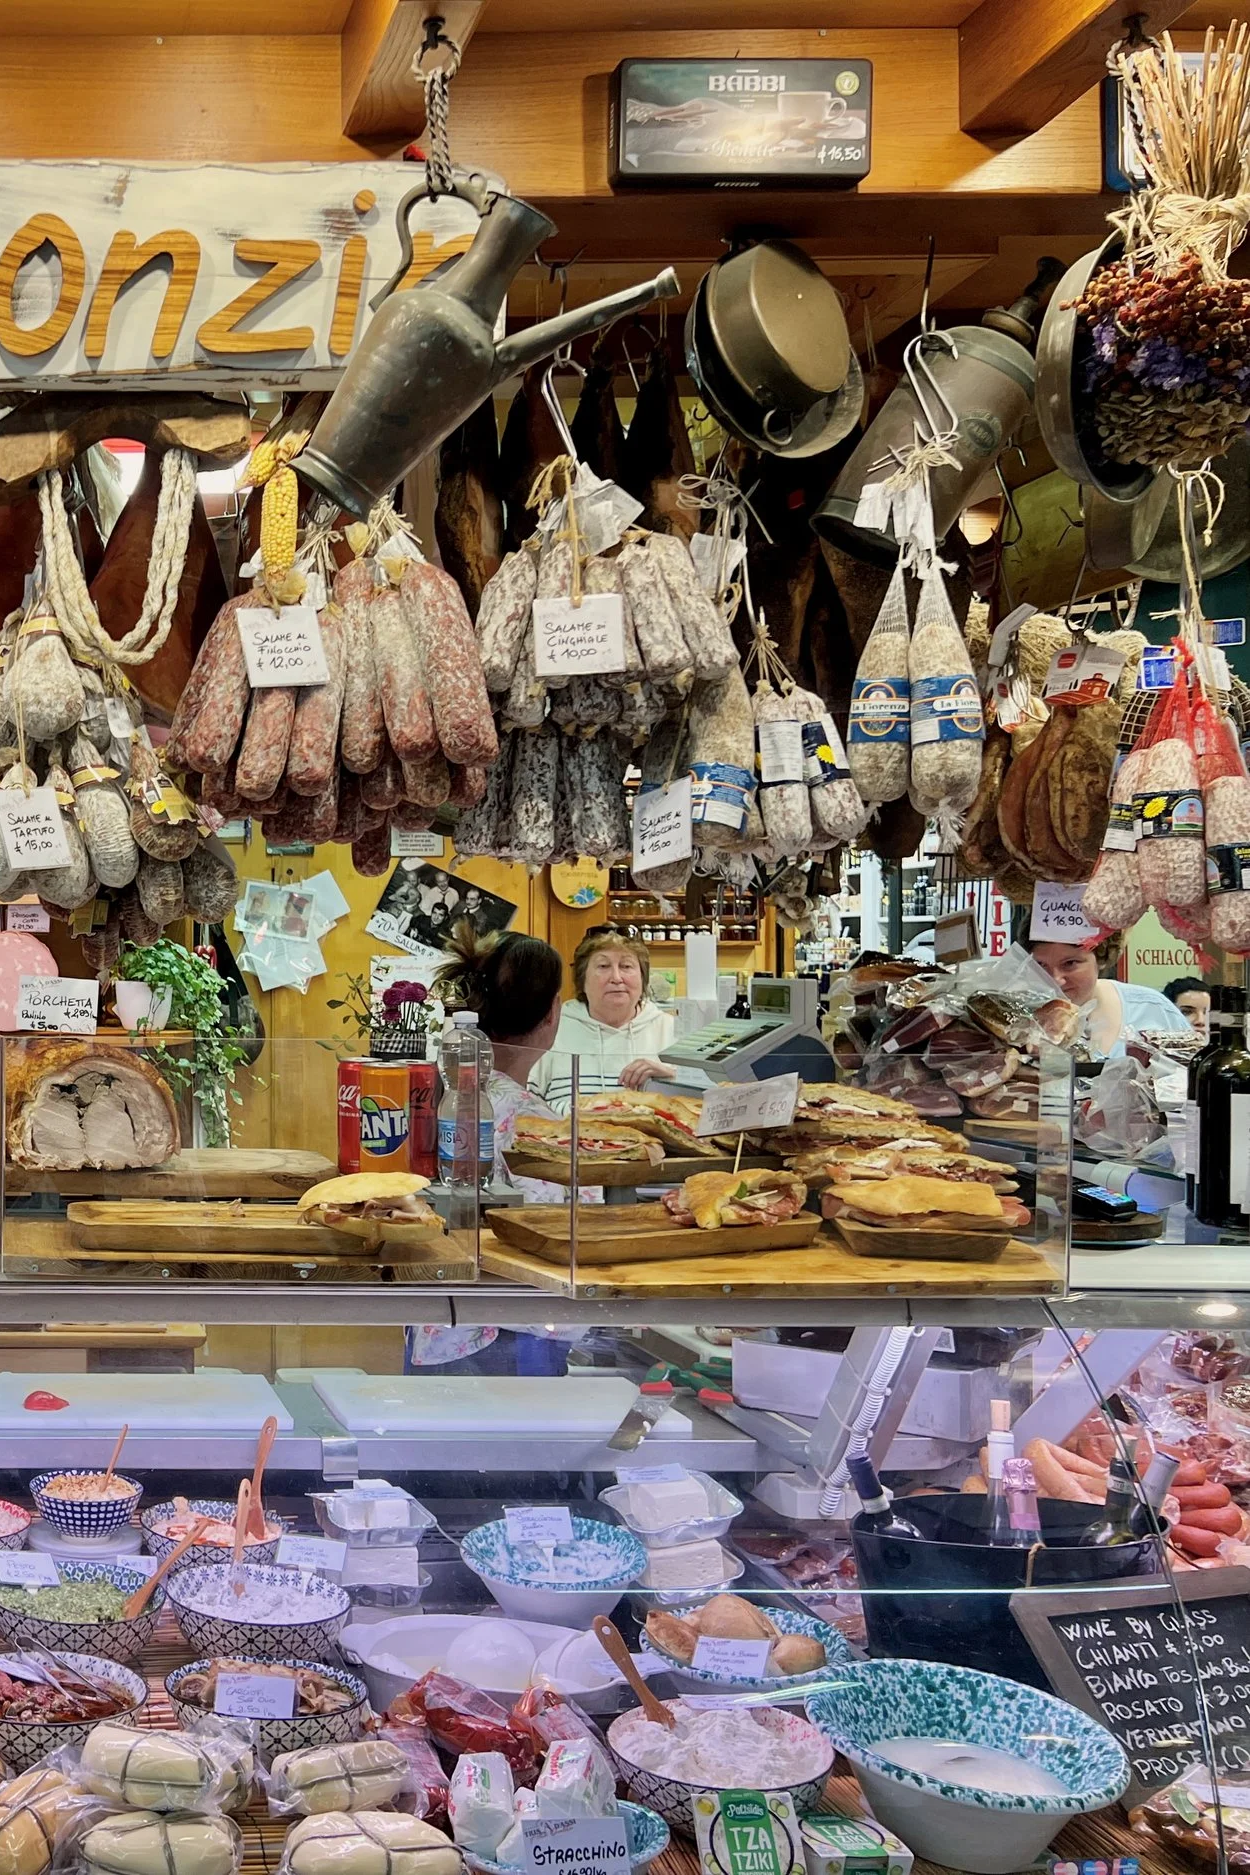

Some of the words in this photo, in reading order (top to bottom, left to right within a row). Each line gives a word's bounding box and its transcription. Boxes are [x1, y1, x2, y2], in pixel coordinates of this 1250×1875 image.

[708, 75, 786, 92] BABBI
[543, 622, 592, 634] SALAME
[253, 632, 292, 646] SALAME
[547, 632, 608, 647] CINGHIALE
[258, 643, 311, 655] FINOCCHIO
[561, 648, 597, 660] 10,00
[270, 656, 303, 669] 12,00
[862, 702, 906, 710] Fiorenza
[8, 812, 41, 825] SALAME
[640, 811, 672, 832] SALAME
[11, 826, 55, 838] TARTUFO
[640, 822, 681, 840] FINOCCHIO
[25, 840, 52, 852] 15,00
[648, 840, 672, 852] 15,00
[28, 990, 93, 1009] PORCHETTA
[37, 1021, 58, 1030] 5,00
[360, 1108, 409, 1139] ANTA
[1059, 1618, 1116, 1642] WINE
[1126, 1616, 1154, 1639] BY
[1076, 1640, 1159, 1670] CHIANTI
[1085, 1667, 1158, 1699] BIANCO
[1101, 1697, 1184, 1724] ROSATO
[815, 1824, 856, 1836] TZA
[729, 1826, 772, 1850] TZA
[828, 1835, 868, 1844] TZIKI
[533, 1840, 626, 1866] STRACCHINO
[733, 1852, 774, 1870] TZIKI
